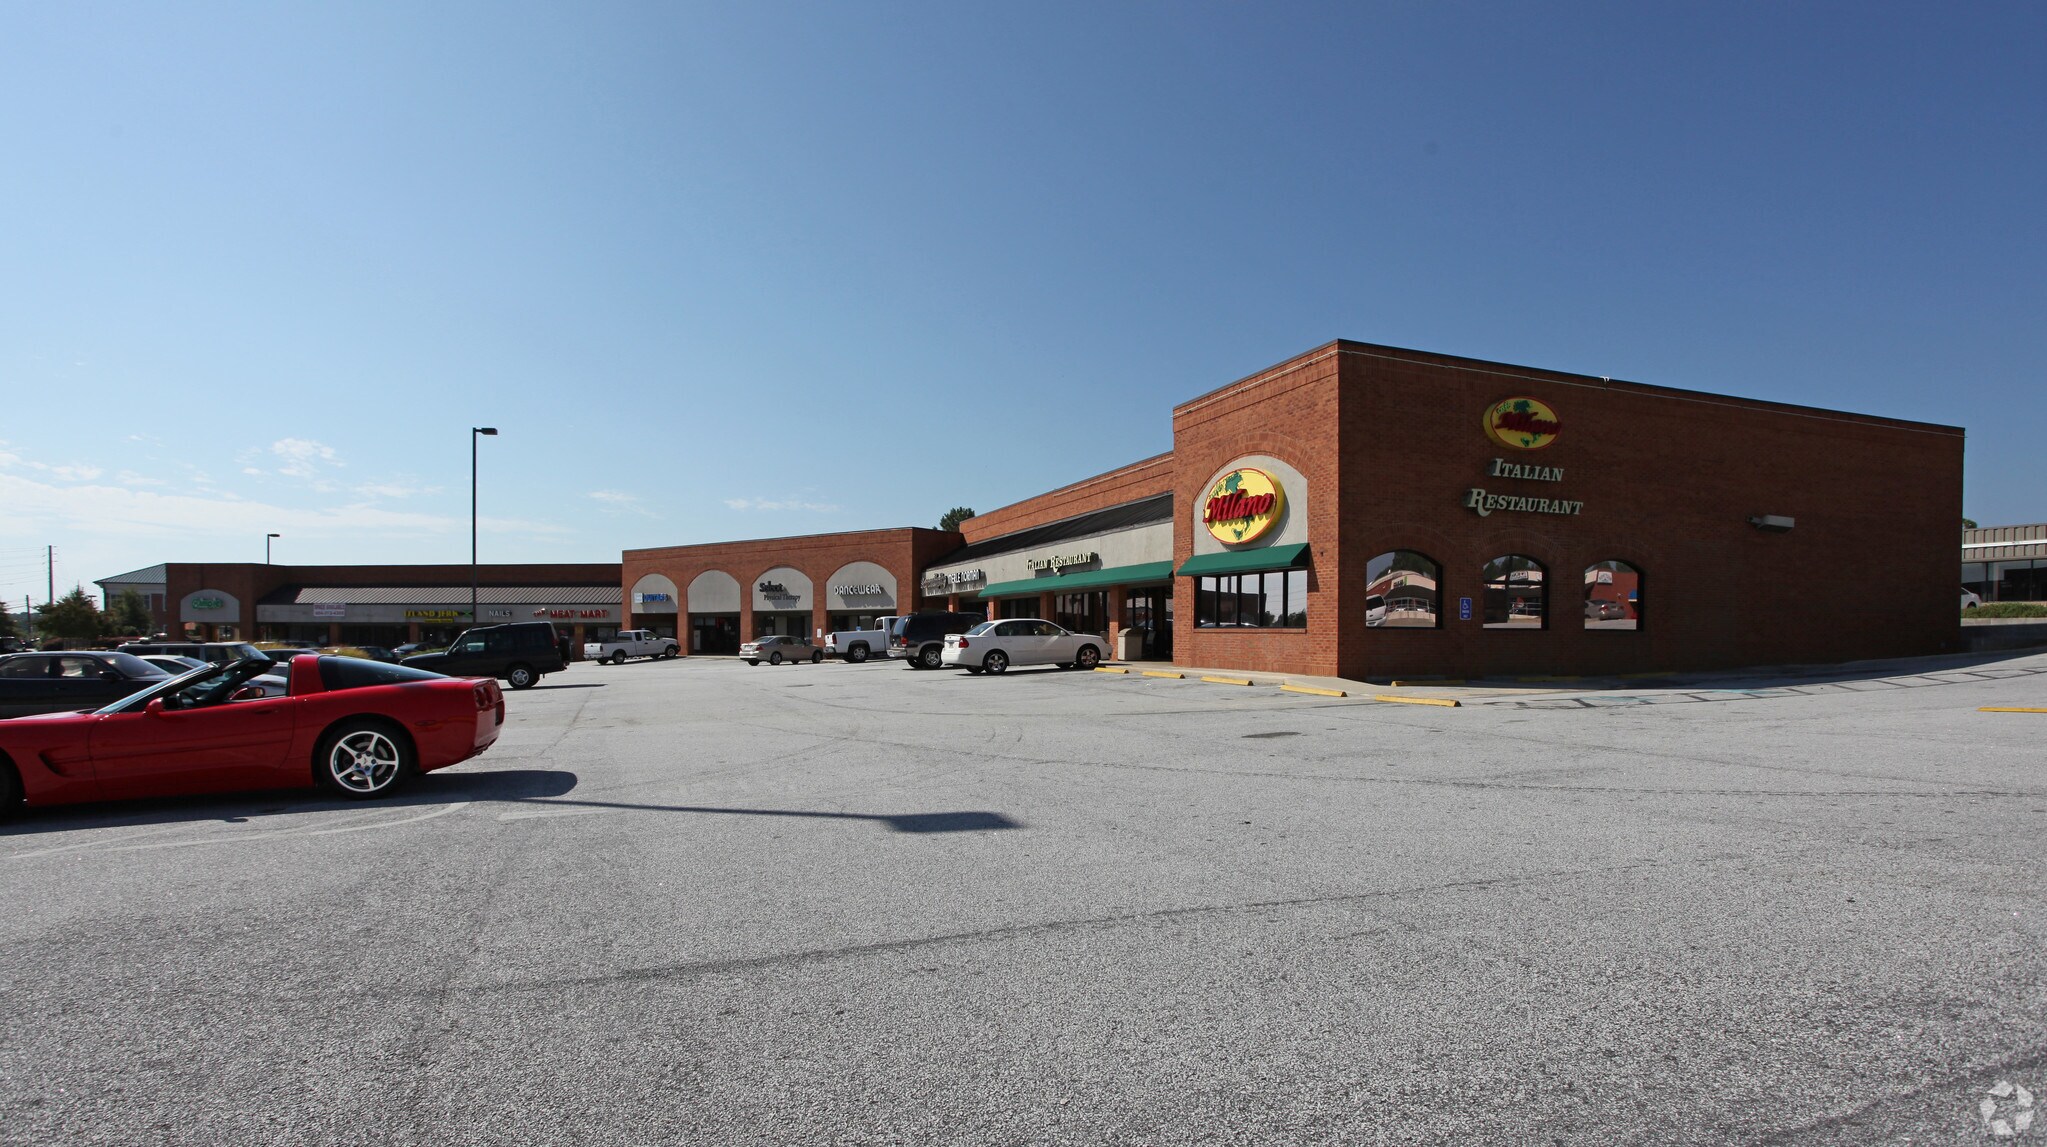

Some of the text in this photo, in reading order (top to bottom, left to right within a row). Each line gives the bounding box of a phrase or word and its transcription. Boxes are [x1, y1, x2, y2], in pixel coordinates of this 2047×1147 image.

[1493, 458, 1564, 481] ITALIAN
[1203, 489, 1275, 523] Milano
[1468, 488, 1583, 517] RESTAURANT
[1026, 553, 1092, 573] ITALIAN RESTAURANT
[759, 581, 784, 592] Select
[833, 584, 882, 595] DANCEWEAR
[549, 609, 576, 618] MEAT
[580, 609, 609, 618] MART
